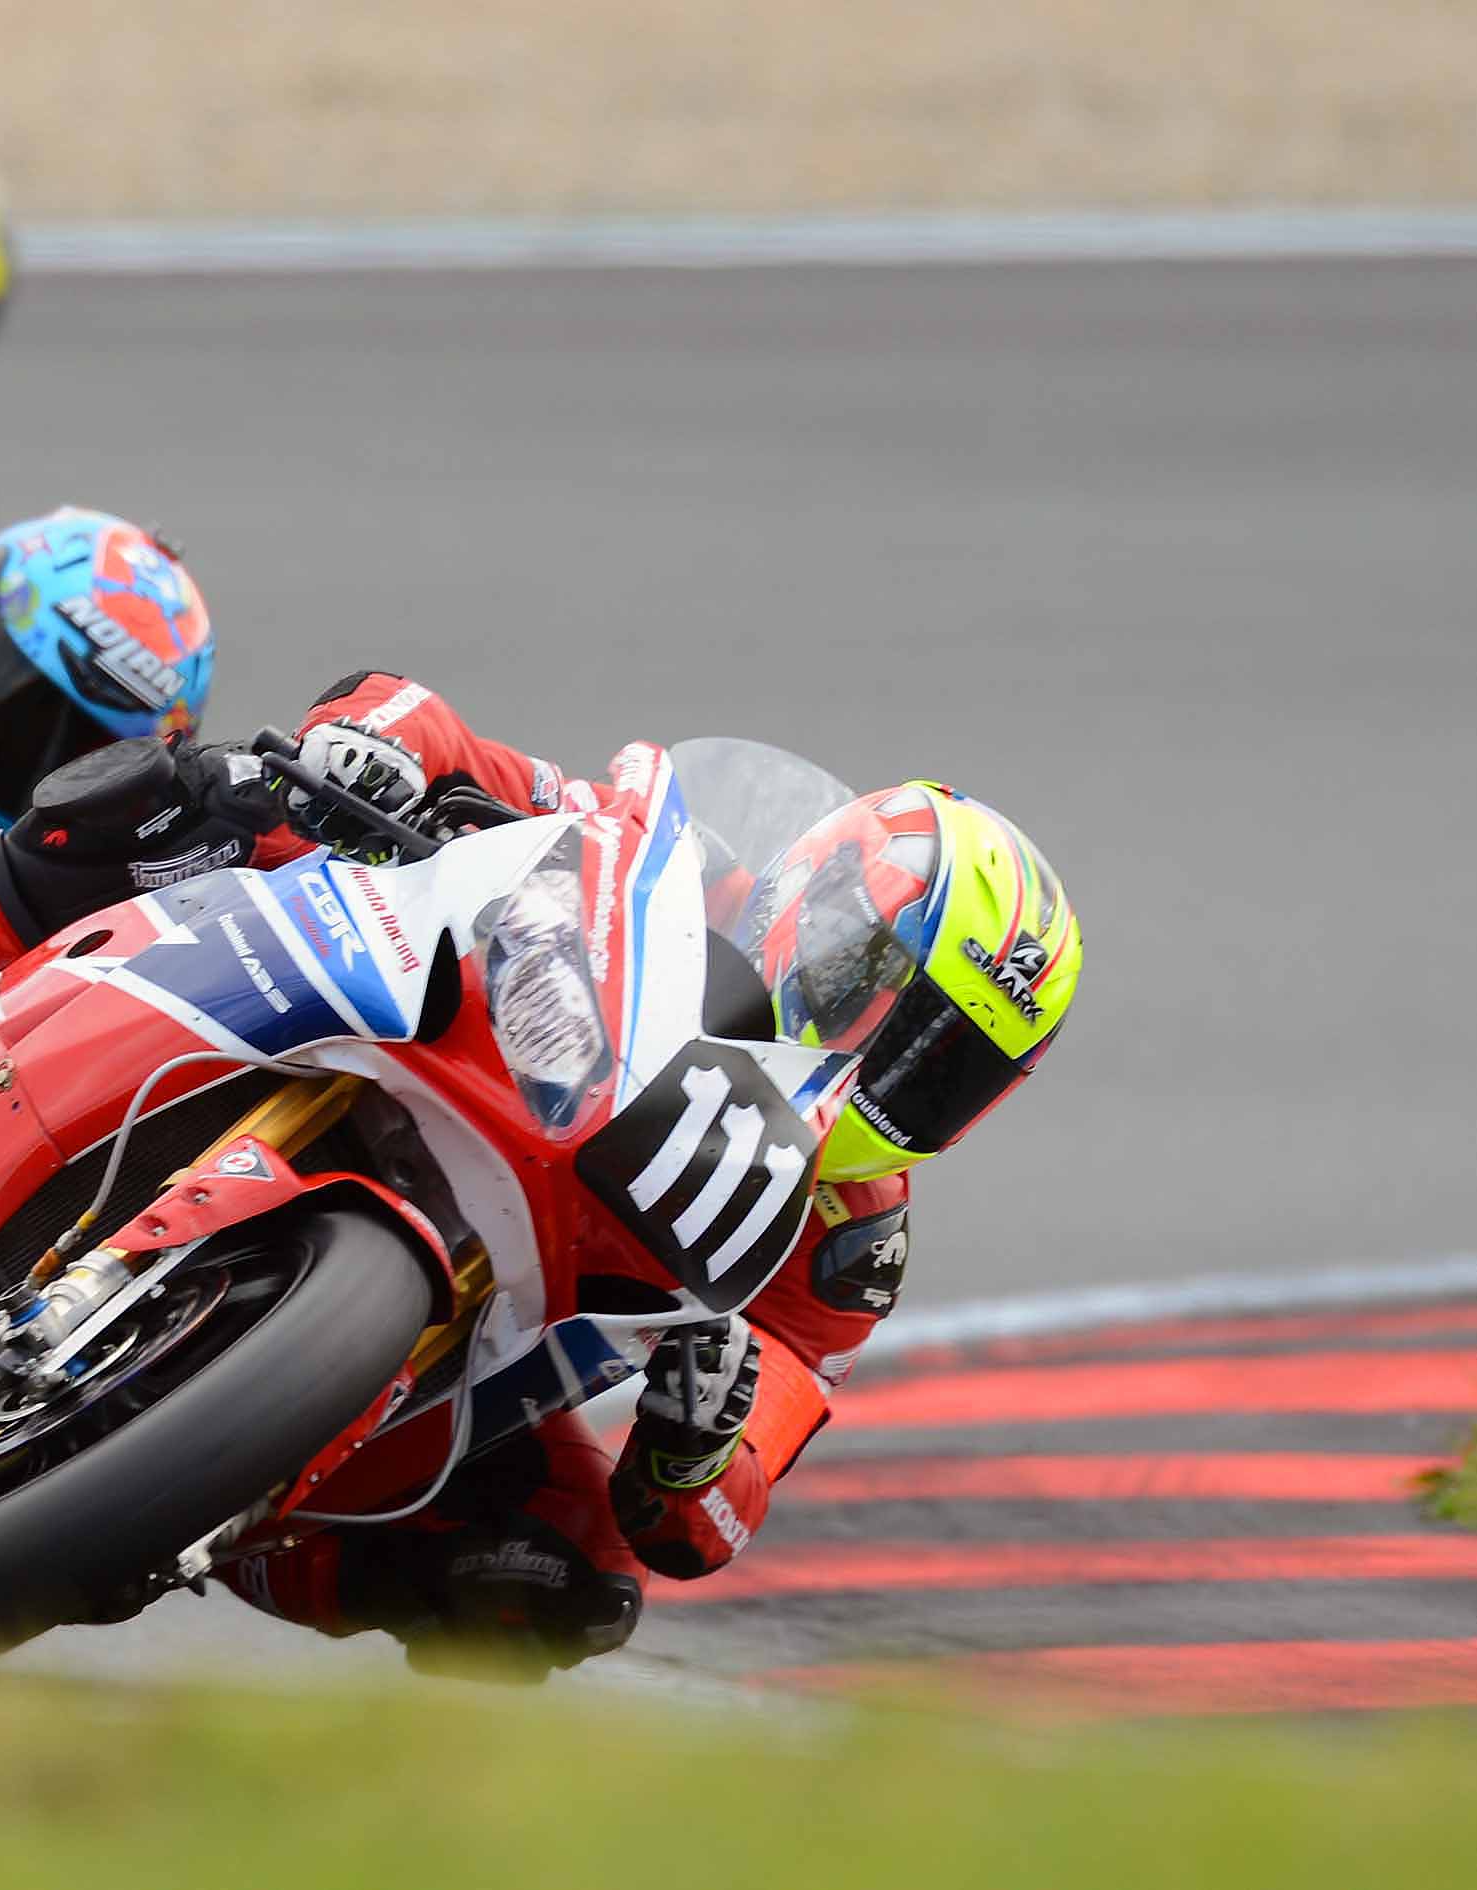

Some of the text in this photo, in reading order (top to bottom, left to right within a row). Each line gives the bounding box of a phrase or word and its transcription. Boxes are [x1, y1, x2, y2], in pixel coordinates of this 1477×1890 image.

[56, 596, 187, 708] NOLAN
[297, 872, 368, 973] CBR
[347, 866, 421, 974] Honda Racing
[961, 937, 1045, 1028] SHARK
[626, 1064, 807, 1283] 111
